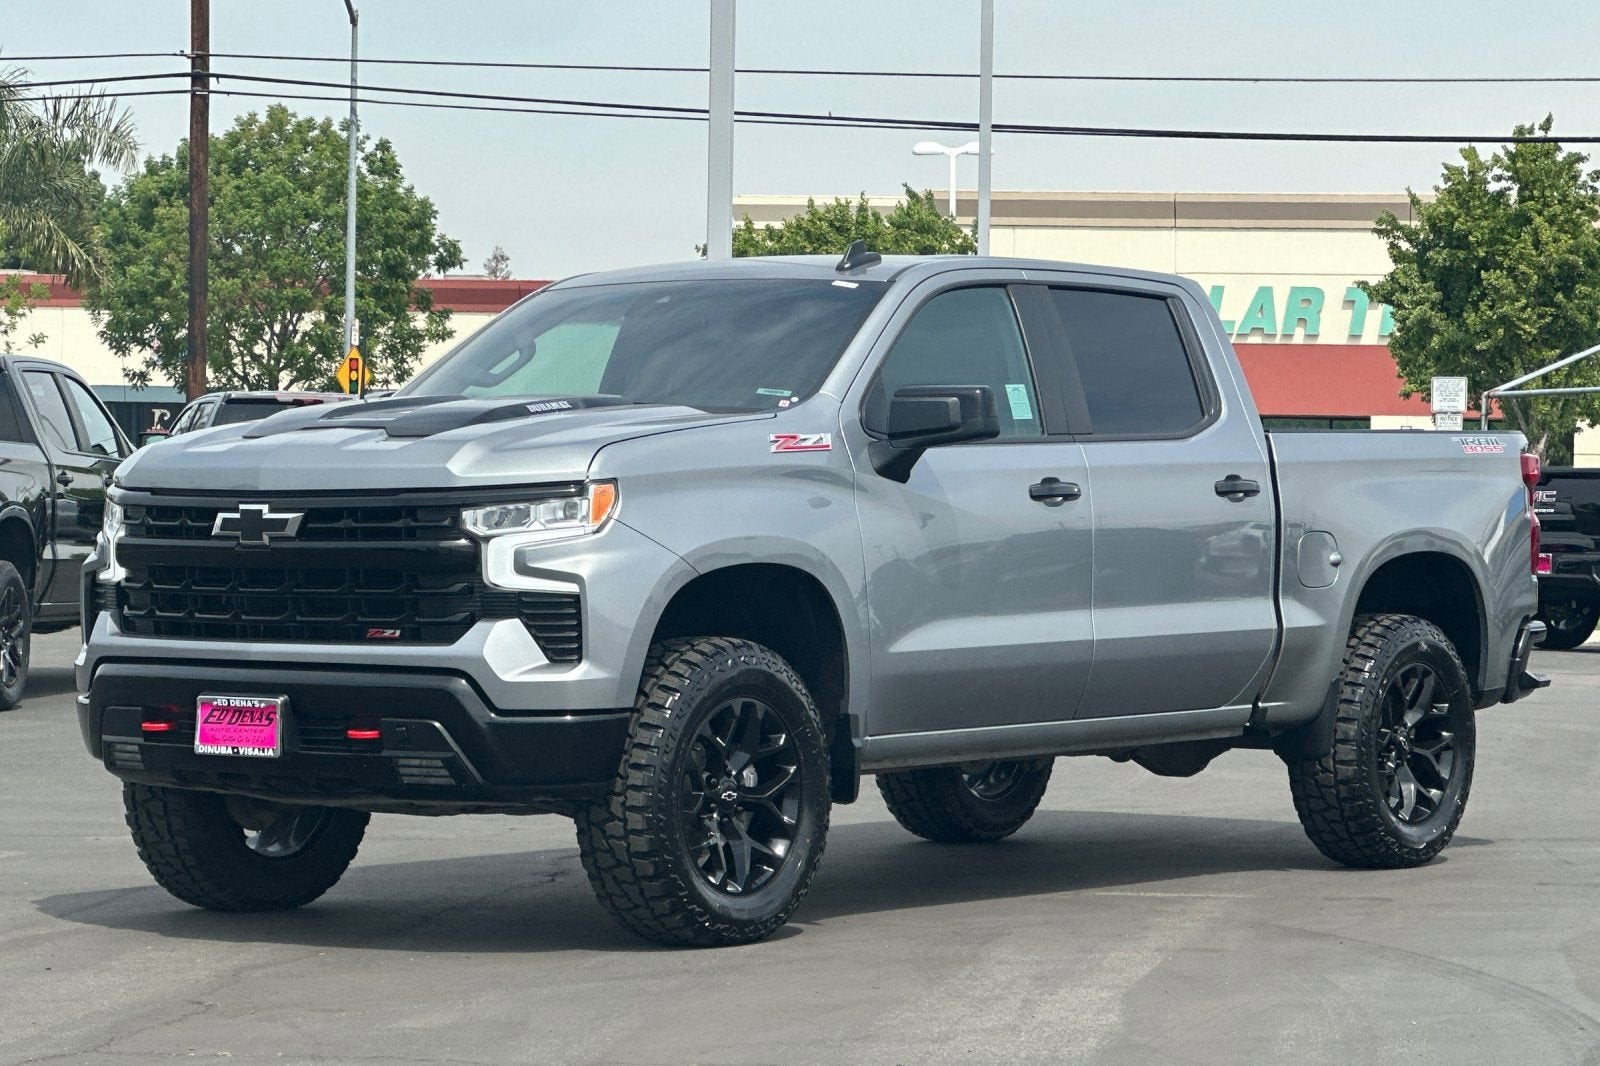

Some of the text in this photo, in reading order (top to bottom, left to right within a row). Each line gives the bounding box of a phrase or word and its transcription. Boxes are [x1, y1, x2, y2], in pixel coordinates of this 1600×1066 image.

[526, 400, 572, 413] DURAMAX
[769, 433, 832, 453] Z71
[1451, 436, 1507, 447] TRAIL
[1462, 445, 1505, 454] BOSS
[367, 628, 401, 638] Z71
[230, 699, 260, 708] DENA'S
[203, 708, 228, 724] ED
[198, 745, 274, 756] DINUBA VISALIA
